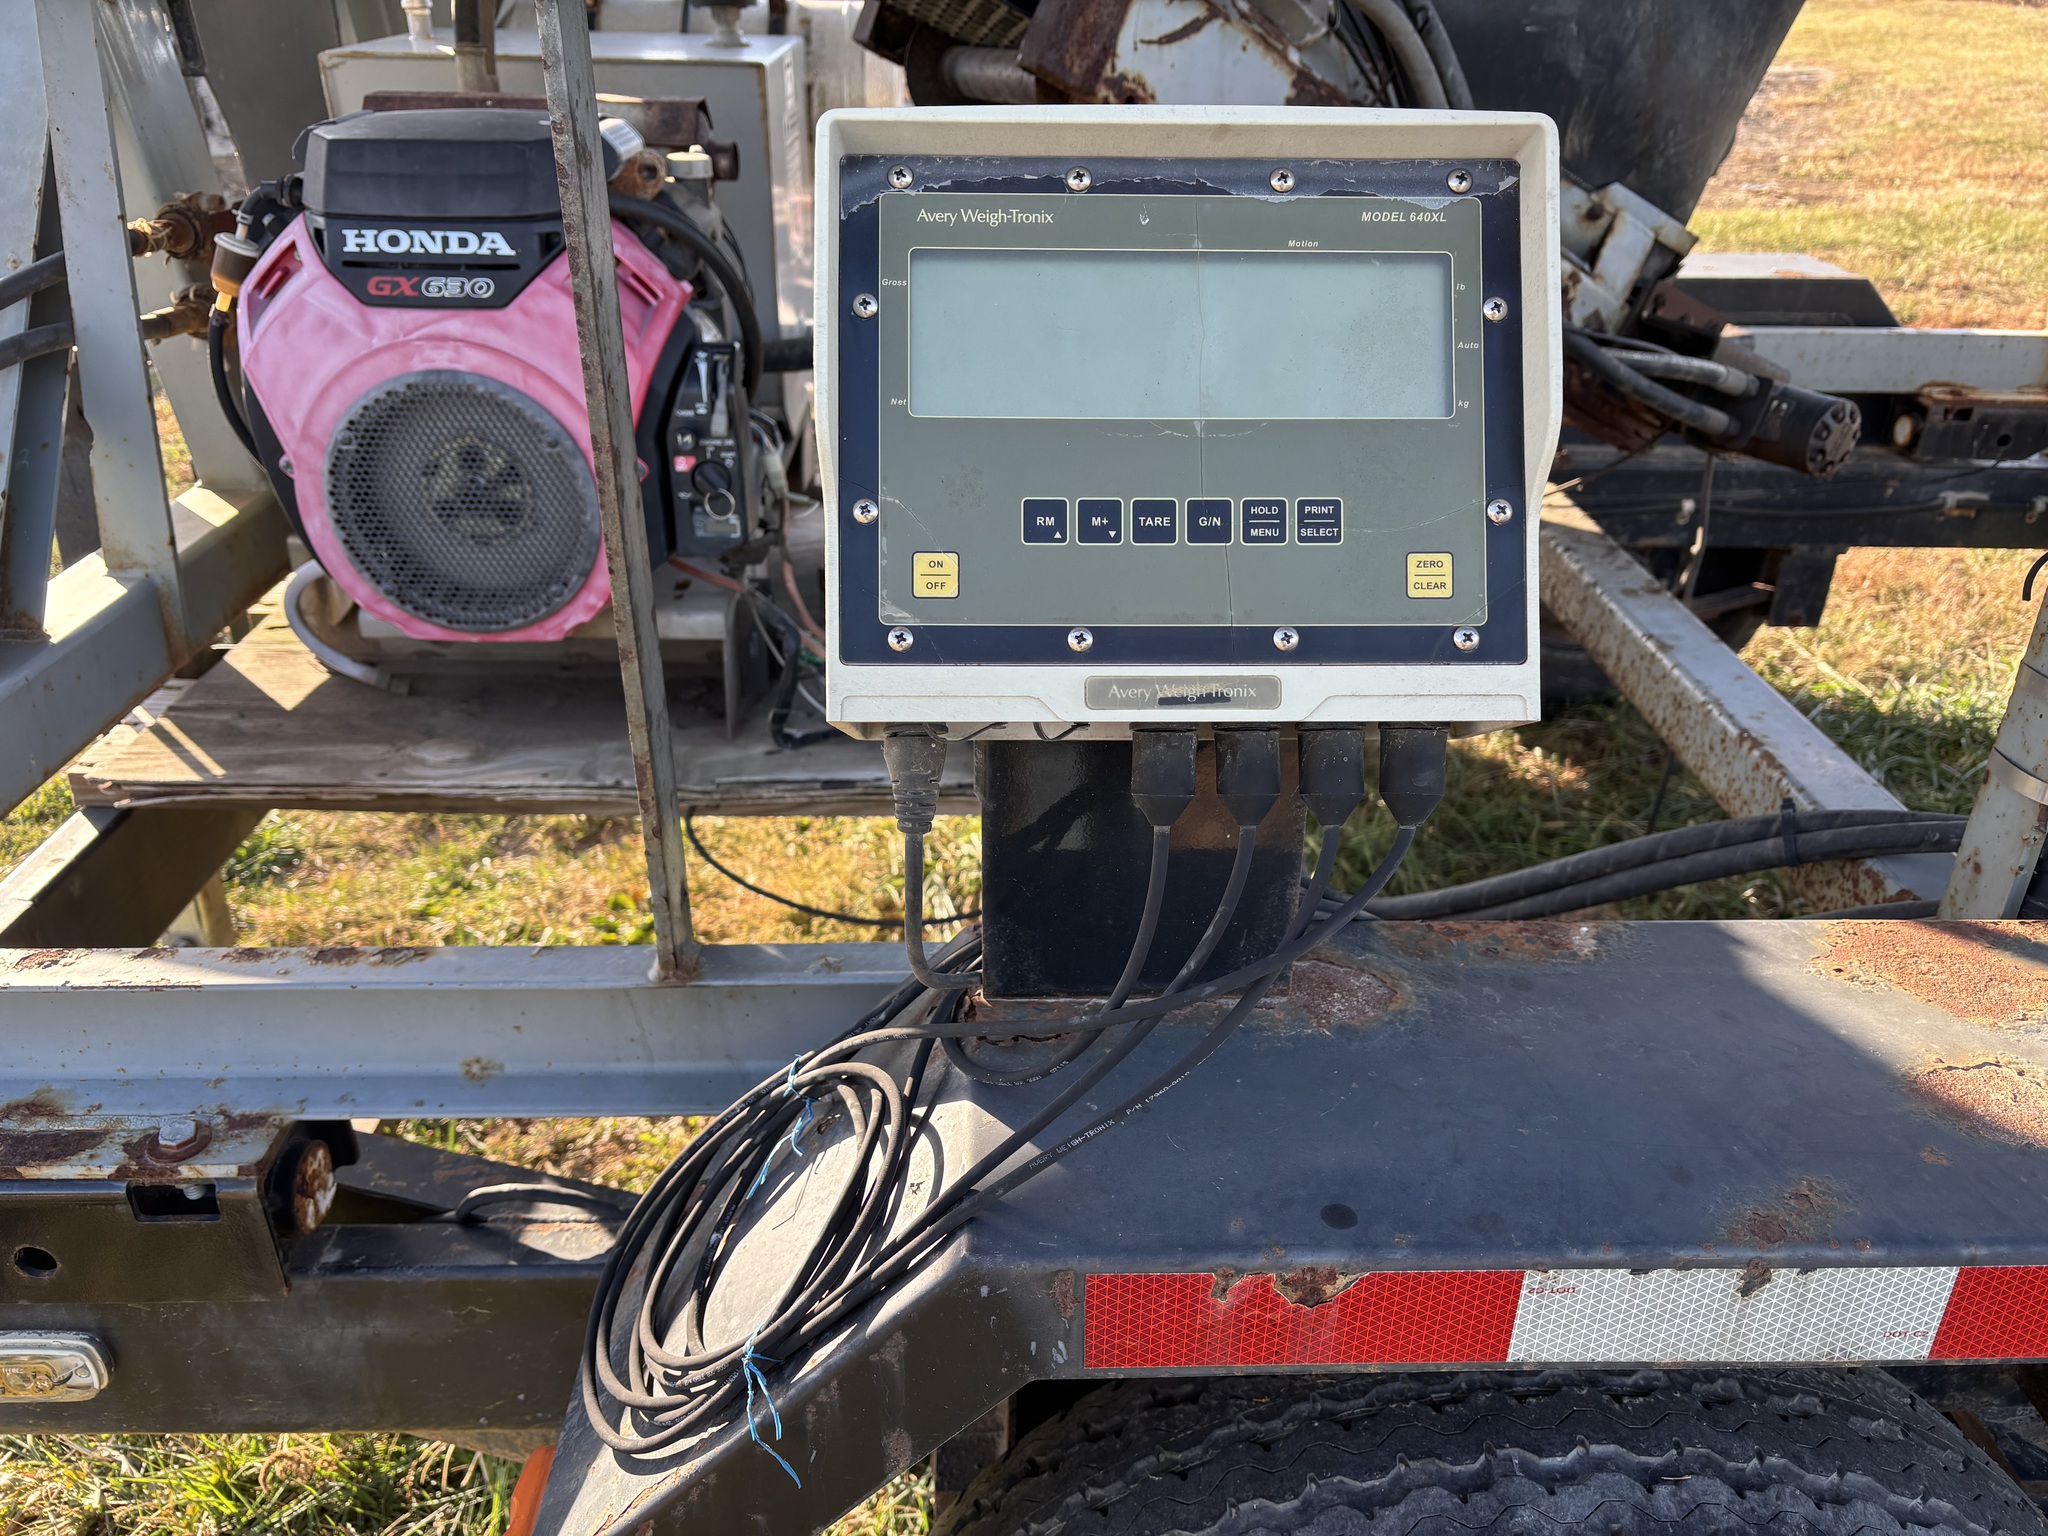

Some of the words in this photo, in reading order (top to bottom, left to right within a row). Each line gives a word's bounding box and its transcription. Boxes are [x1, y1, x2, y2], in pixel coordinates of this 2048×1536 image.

[916, 208, 958, 227] Avery
[960, 208, 1054, 227] Weigh-Tronix
[1361, 211, 1407, 223] MODEL
[1409, 211, 1447, 223] 640XL
[341, 228, 517, 257] HONDA
[1288, 239, 1319, 248] Motion
[881, 278, 908, 286] Gross
[367, 276, 496, 299] GX630
[1456, 283, 1466, 291] lb
[1457, 341, 1480, 349] Auto
[890, 398, 907, 406] Net
[1458, 400, 1470, 409] kg
[1250, 506, 1279, 515] HOLD
[1304, 506, 1335, 515] PRINT
[1036, 516, 1055, 527] RM
[1091, 516, 1109, 527] M+
[1138, 516, 1171, 527] TARE
[1198, 516, 1221, 527] G/N
[1250, 528, 1280, 537] MENU
[1300, 528, 1339, 537] SELECT
[928, 560, 944, 569] ON
[1416, 560, 1444, 569] ZERO
[925, 581, 947, 590] OFF
[1413, 581, 1447, 590] CLEAR
[1107, 684, 1152, 702] Avery
